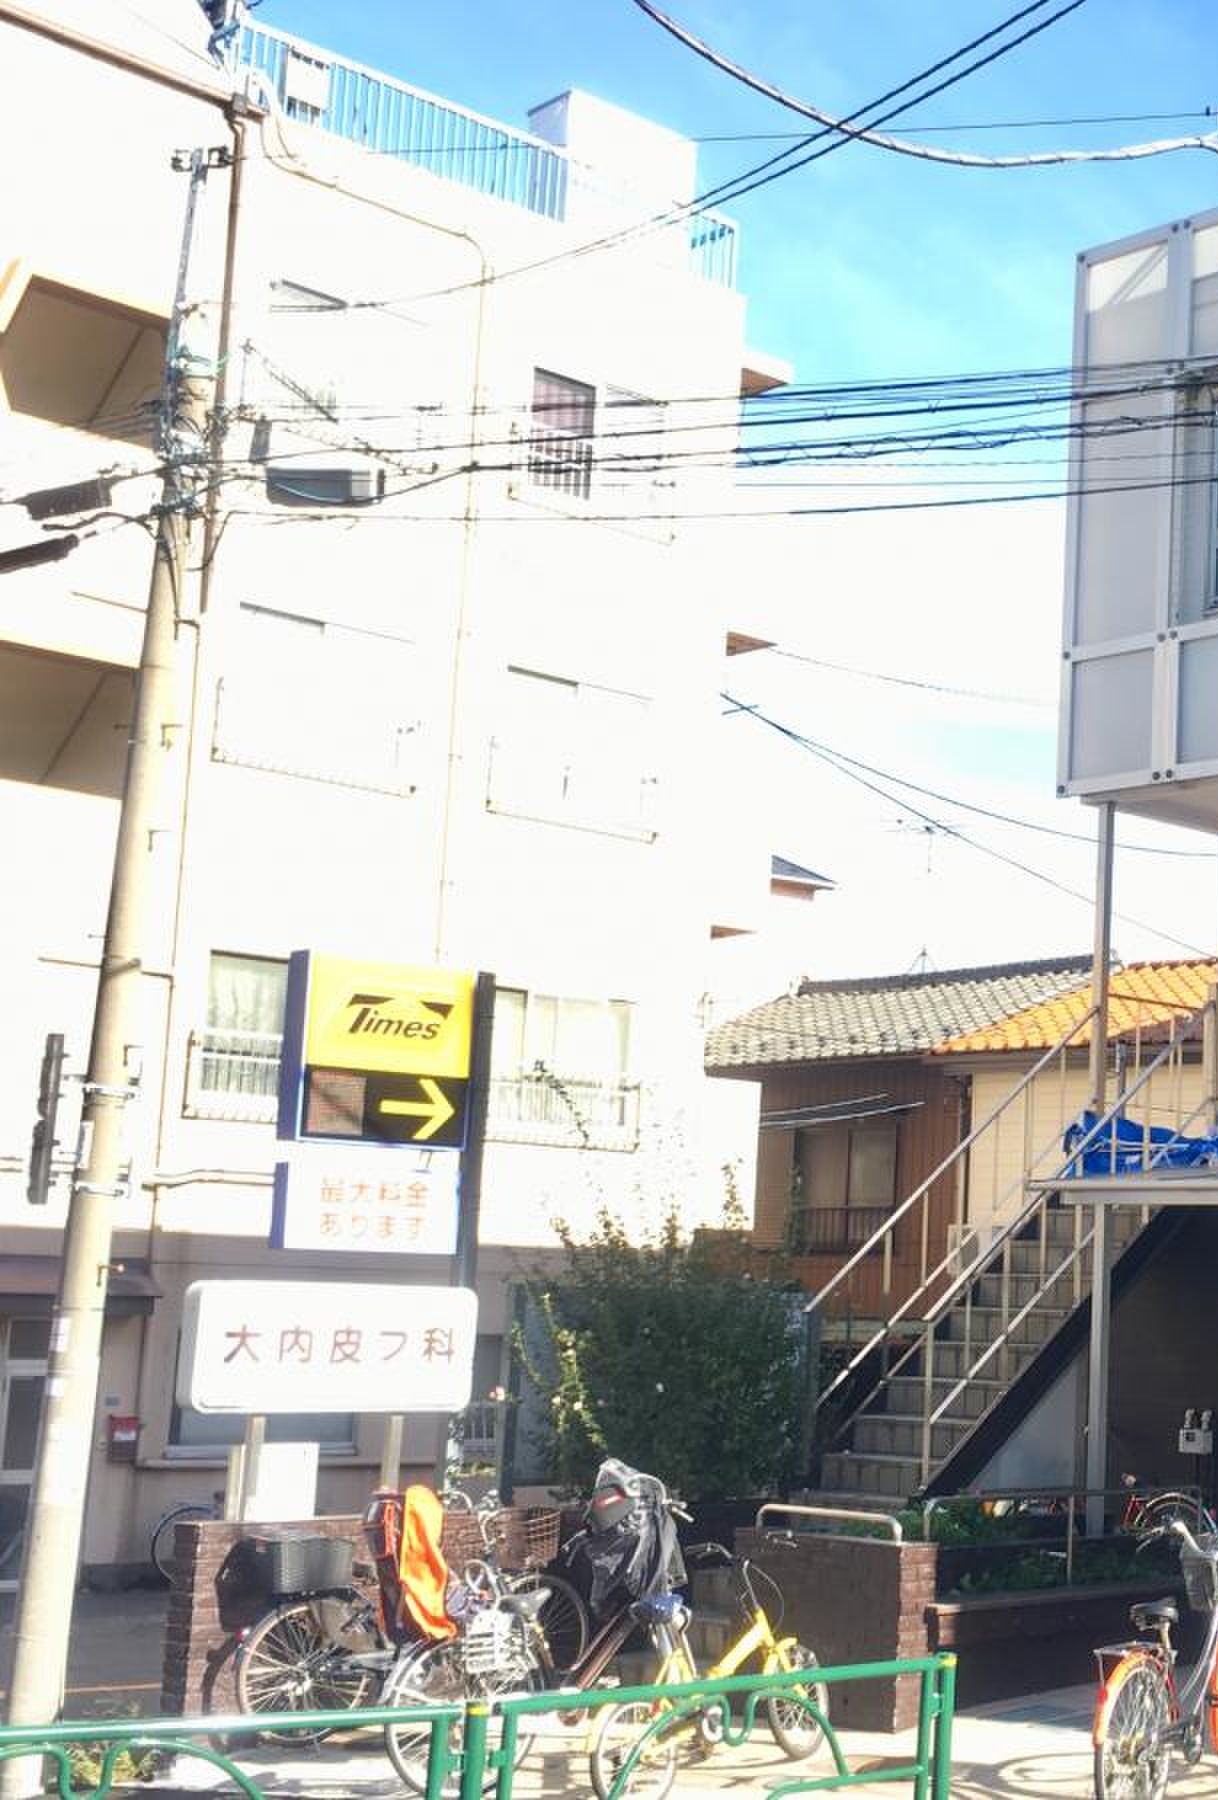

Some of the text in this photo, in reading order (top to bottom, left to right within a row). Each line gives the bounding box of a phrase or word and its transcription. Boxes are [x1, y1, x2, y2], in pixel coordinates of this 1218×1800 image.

[346, 993, 453, 1041] Times
[223, 1324, 456, 1364] 大内皮フ科
